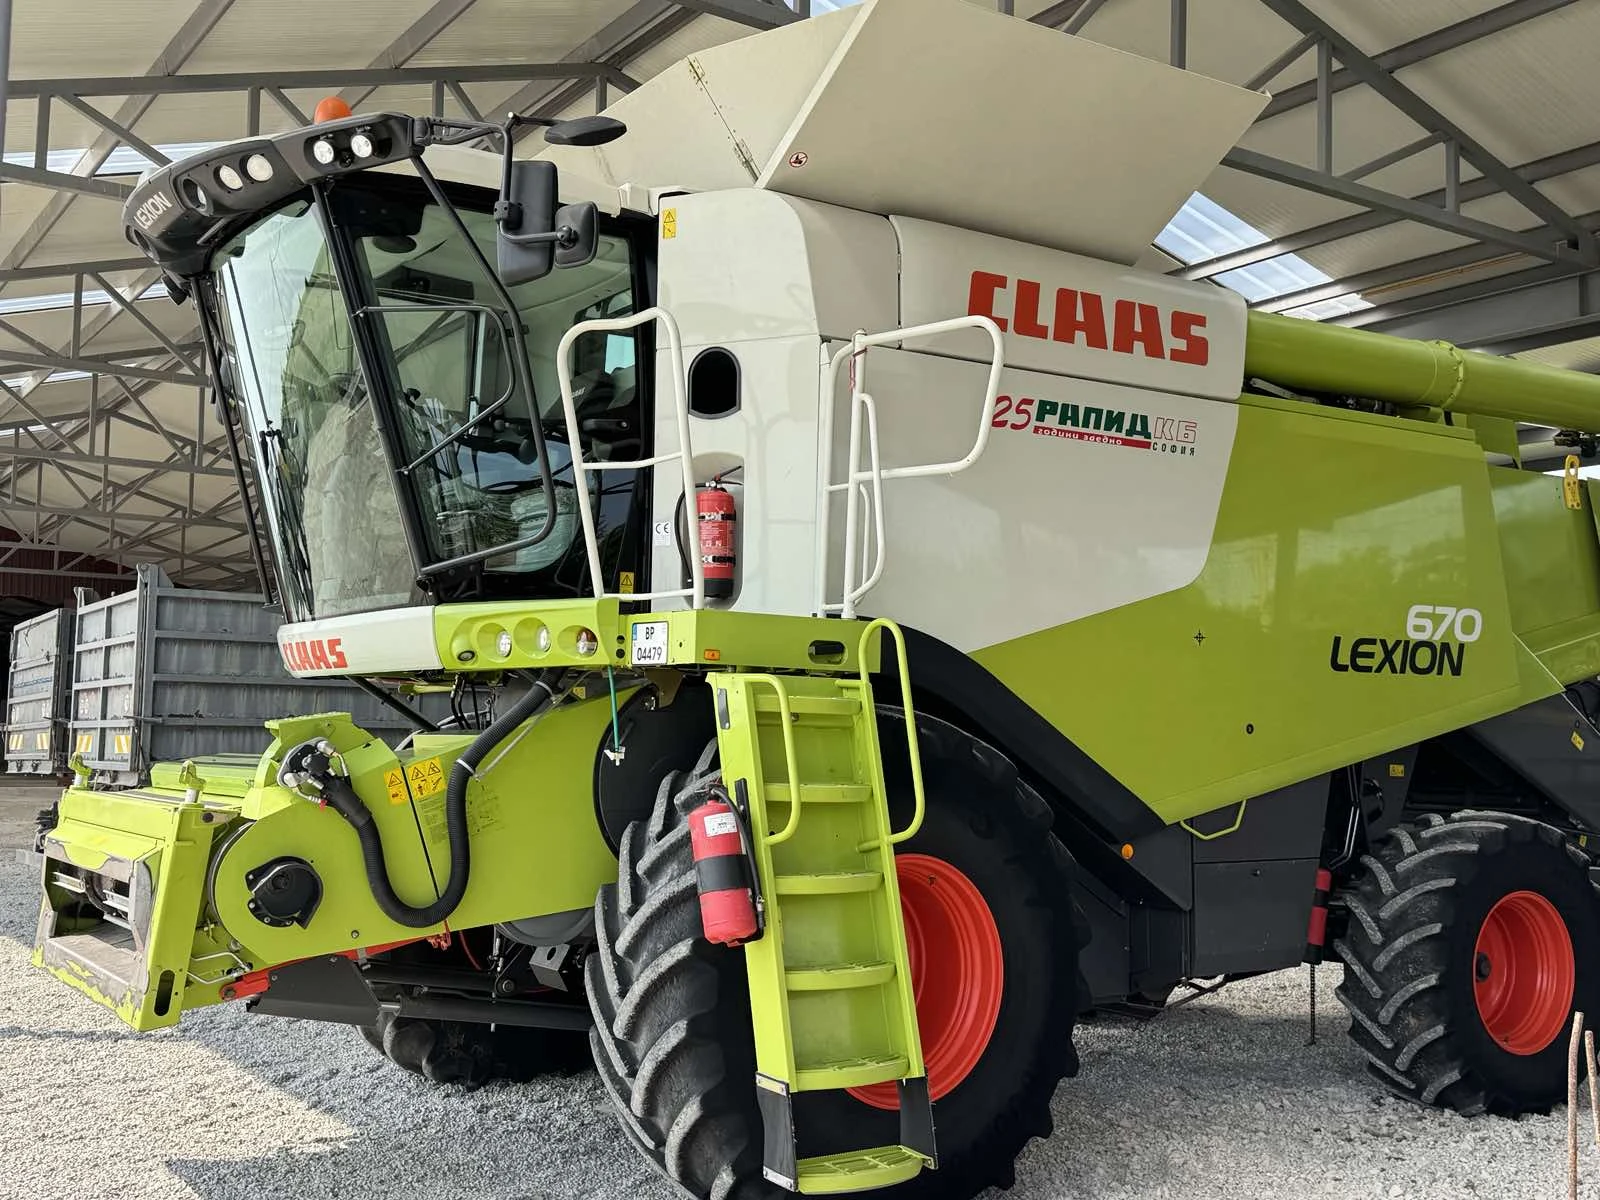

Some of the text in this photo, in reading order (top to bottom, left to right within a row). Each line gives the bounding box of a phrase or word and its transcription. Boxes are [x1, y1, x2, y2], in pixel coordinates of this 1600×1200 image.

[133, 191, 173, 230] LEXION
[968, 270, 1209, 366] CLAAS
[992, 395, 1198, 443] 25 РАПИД КБ
[1152, 443, 1196, 457] СОФИЯ
[1406, 604, 1483, 643] 670
[636, 646, 663, 661] 04479
[1330, 636, 1465, 677] LEXION
